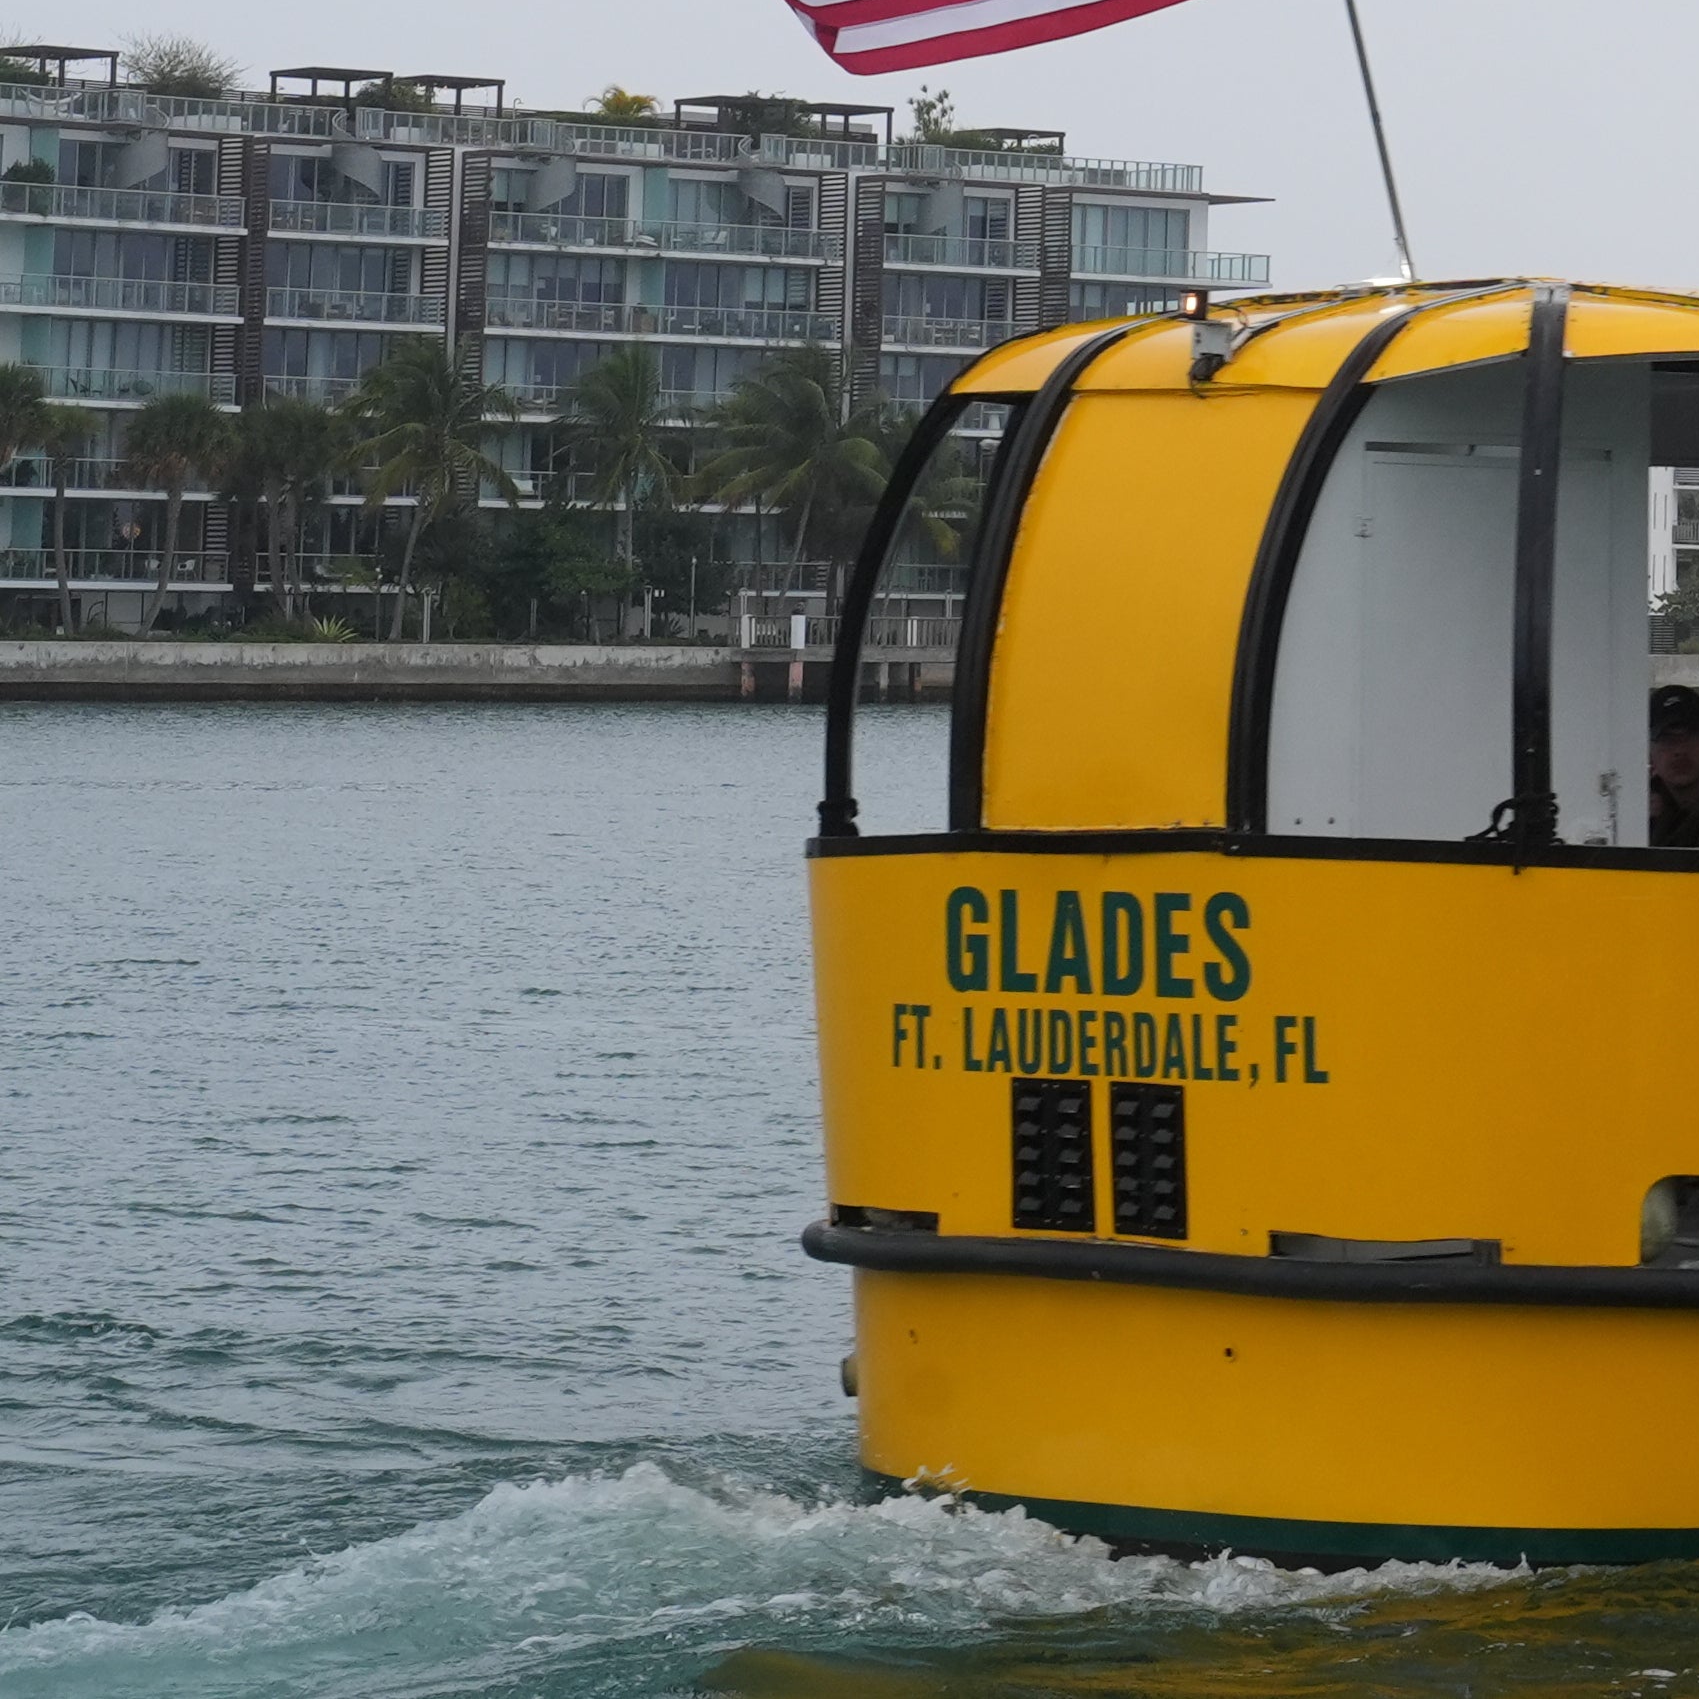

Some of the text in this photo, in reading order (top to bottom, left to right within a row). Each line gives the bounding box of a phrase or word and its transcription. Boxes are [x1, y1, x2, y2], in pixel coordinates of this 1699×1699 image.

[946, 886, 1251, 1001] GLADES
[892, 1003, 1329, 1088] FT. LAUDERDALE, FL
